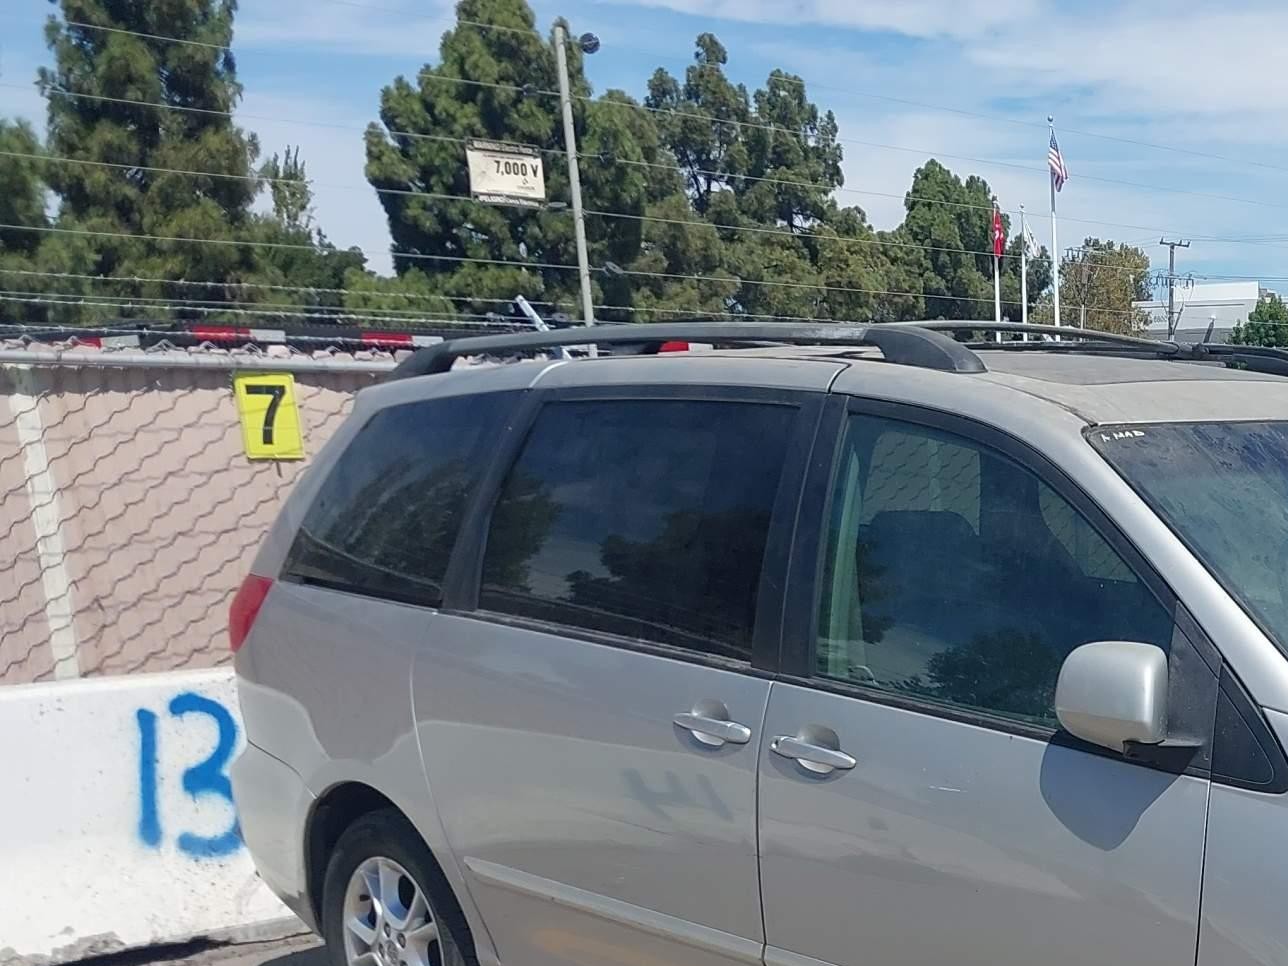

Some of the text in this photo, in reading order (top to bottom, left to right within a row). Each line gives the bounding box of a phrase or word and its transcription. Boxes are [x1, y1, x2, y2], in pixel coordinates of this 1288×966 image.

[494, 160, 539, 178] 7,000 V
[245, 384, 286, 445] 7
[136, 692, 243, 857] 13
